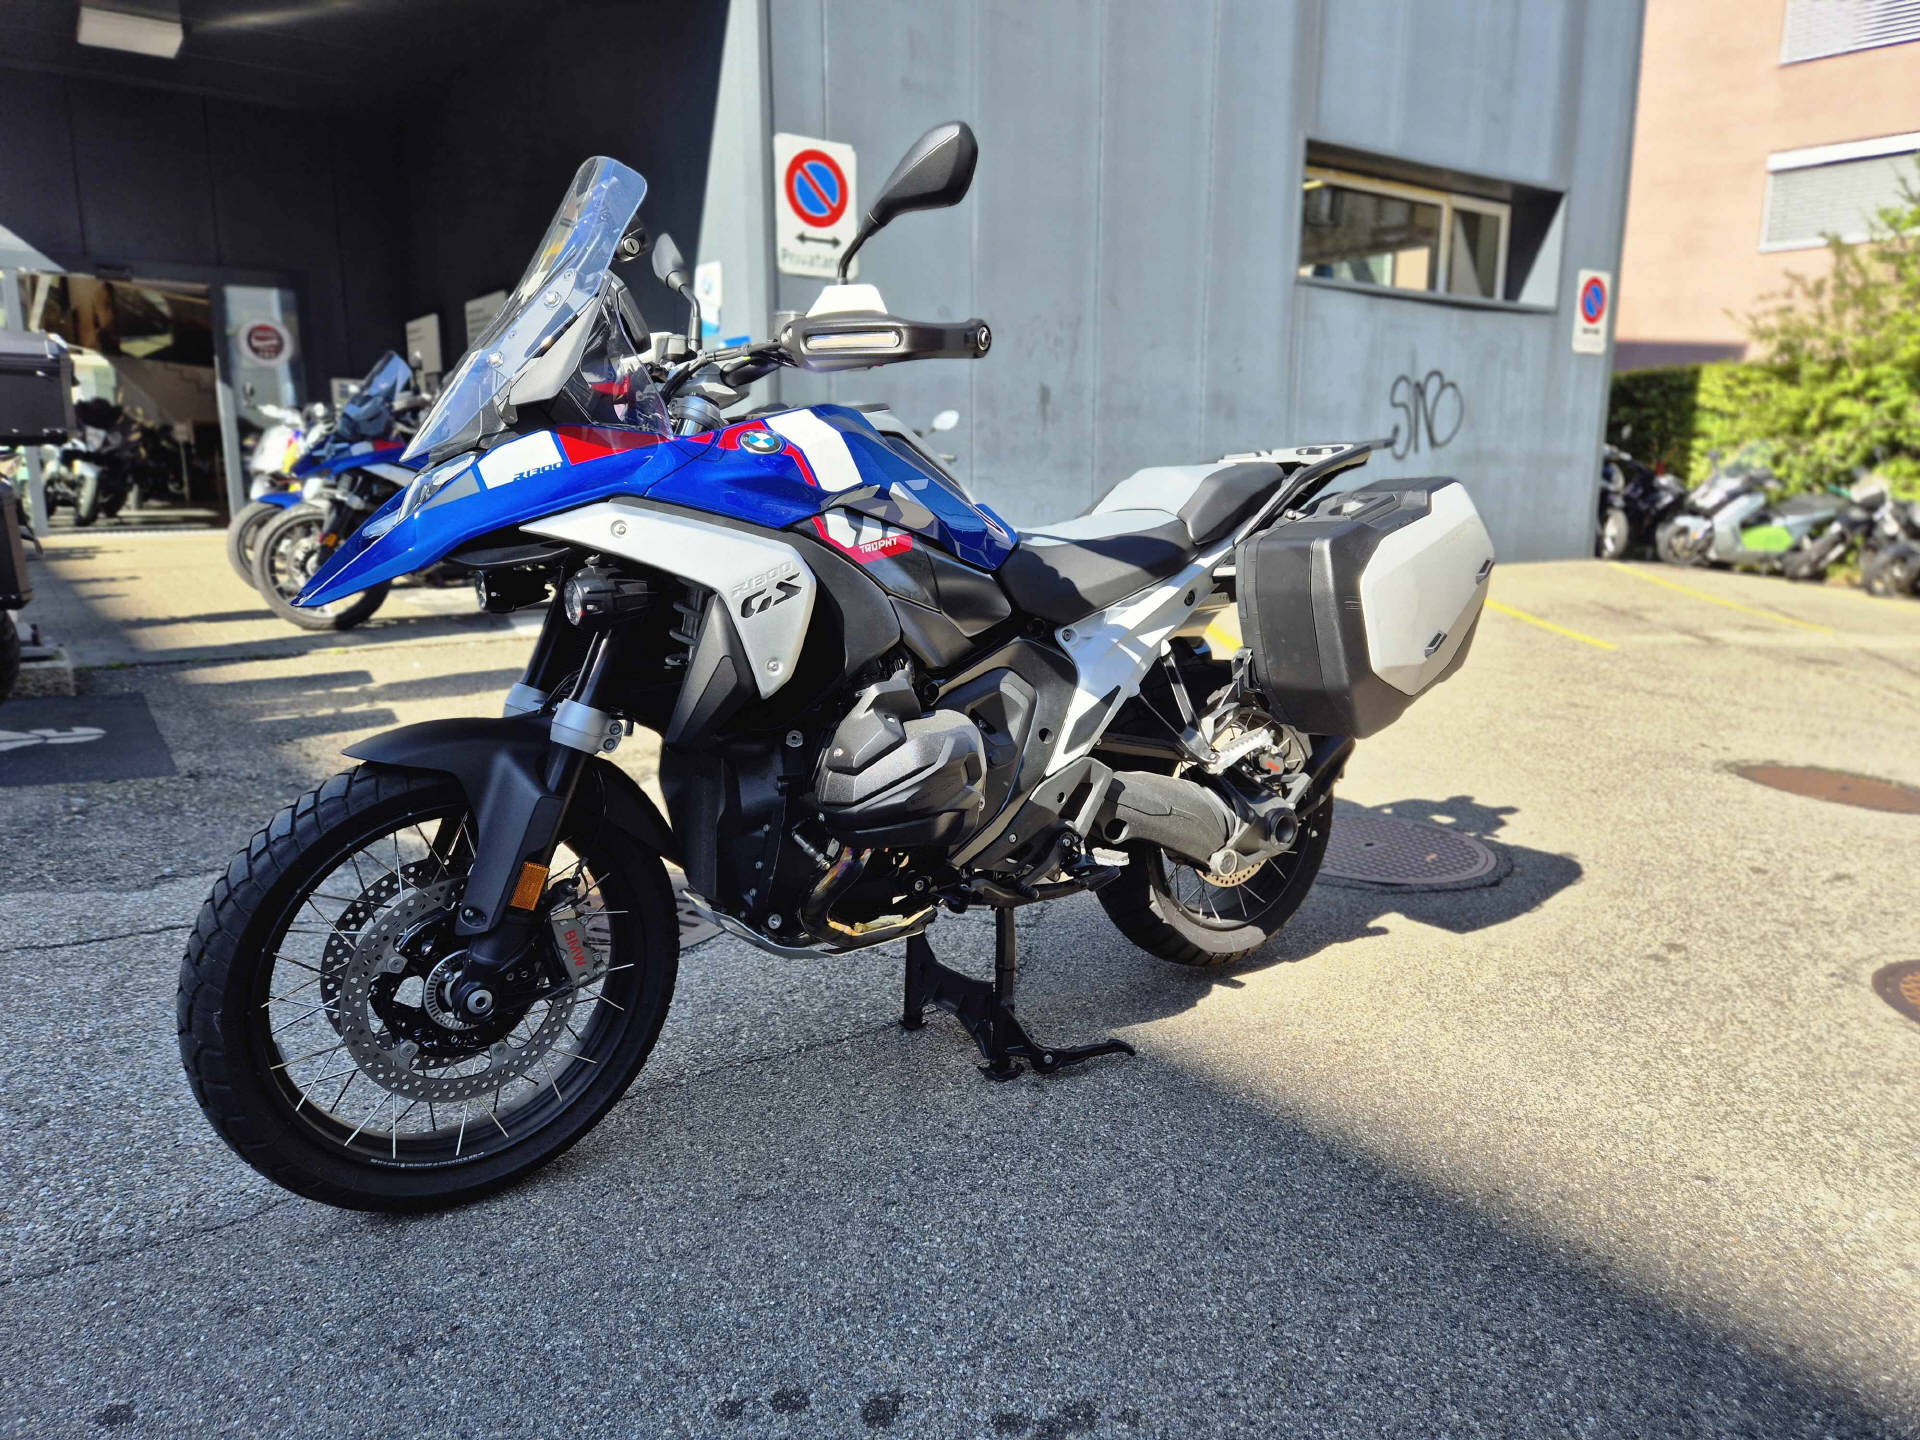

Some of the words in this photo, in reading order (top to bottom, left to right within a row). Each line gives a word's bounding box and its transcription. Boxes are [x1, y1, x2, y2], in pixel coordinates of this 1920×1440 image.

[859, 537, 897, 554] TROPHY
[740, 572, 803, 618] GS
[563, 929, 588, 967] BMW
